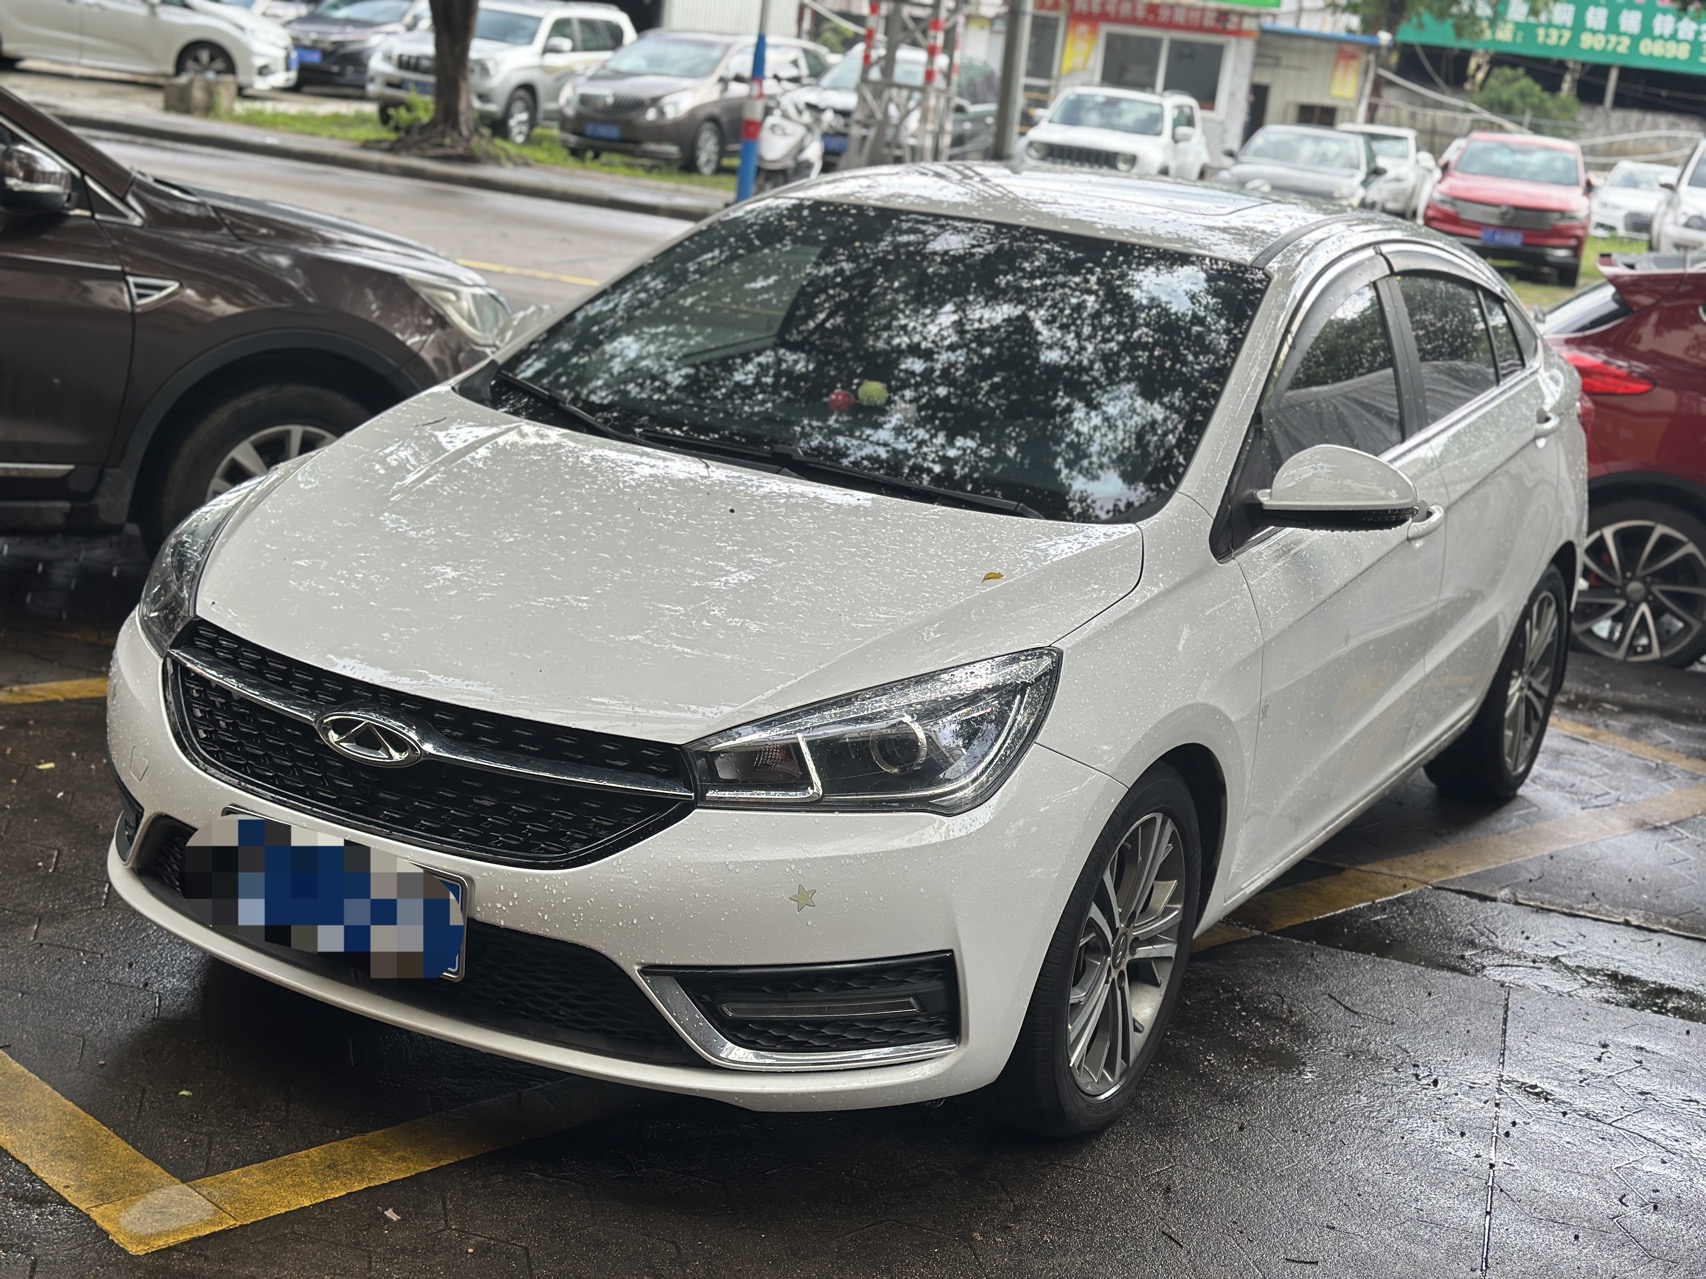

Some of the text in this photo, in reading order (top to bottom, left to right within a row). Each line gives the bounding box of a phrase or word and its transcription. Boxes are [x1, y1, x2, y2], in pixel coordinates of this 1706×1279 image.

[1535, 26, 1572, 47] 137
[1579, 31, 1631, 54] 9072
[1638, 37, 1691, 61] 0698
